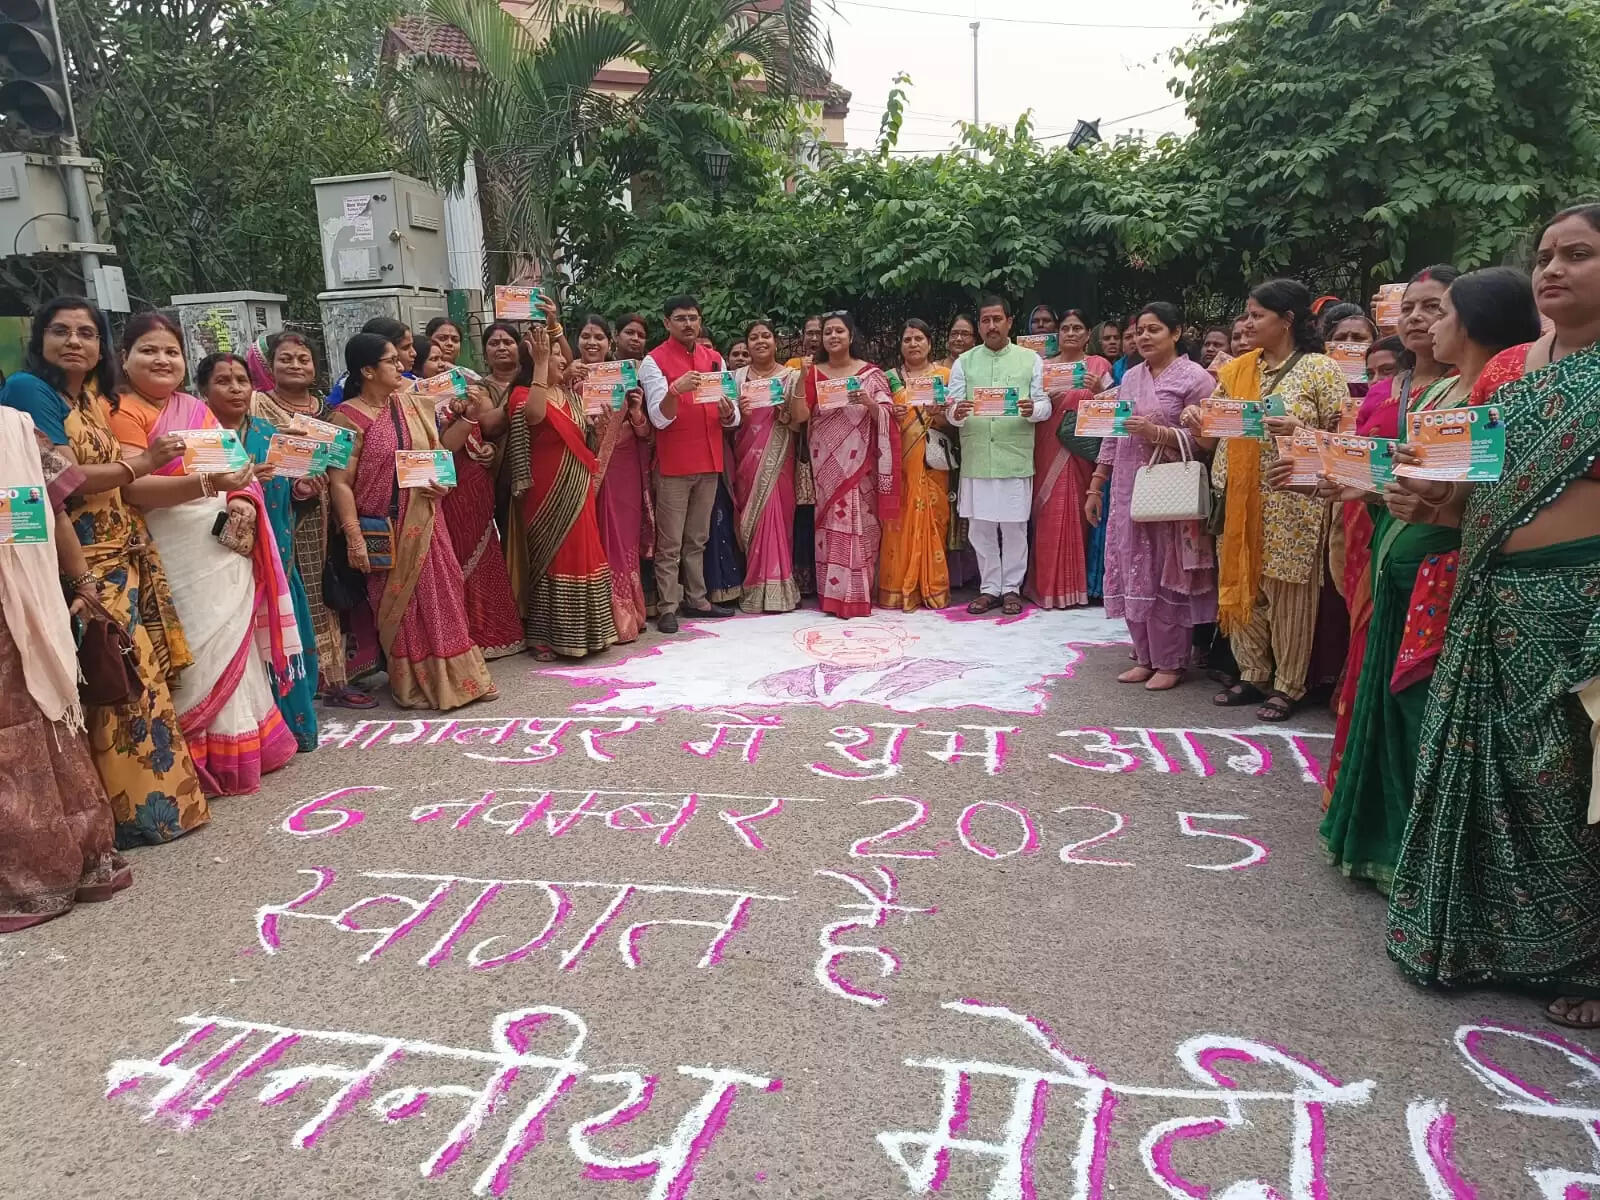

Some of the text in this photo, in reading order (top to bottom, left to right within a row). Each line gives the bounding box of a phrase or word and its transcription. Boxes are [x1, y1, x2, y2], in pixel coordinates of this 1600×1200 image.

[282, 785, 395, 839] 6
[849, 794, 1272, 870] 2025
[255, 864, 939, 1007] स्वागत है
[105, 1005, 783, 1200] माननीय
[876, 998, 1376, 1200] मोदी
